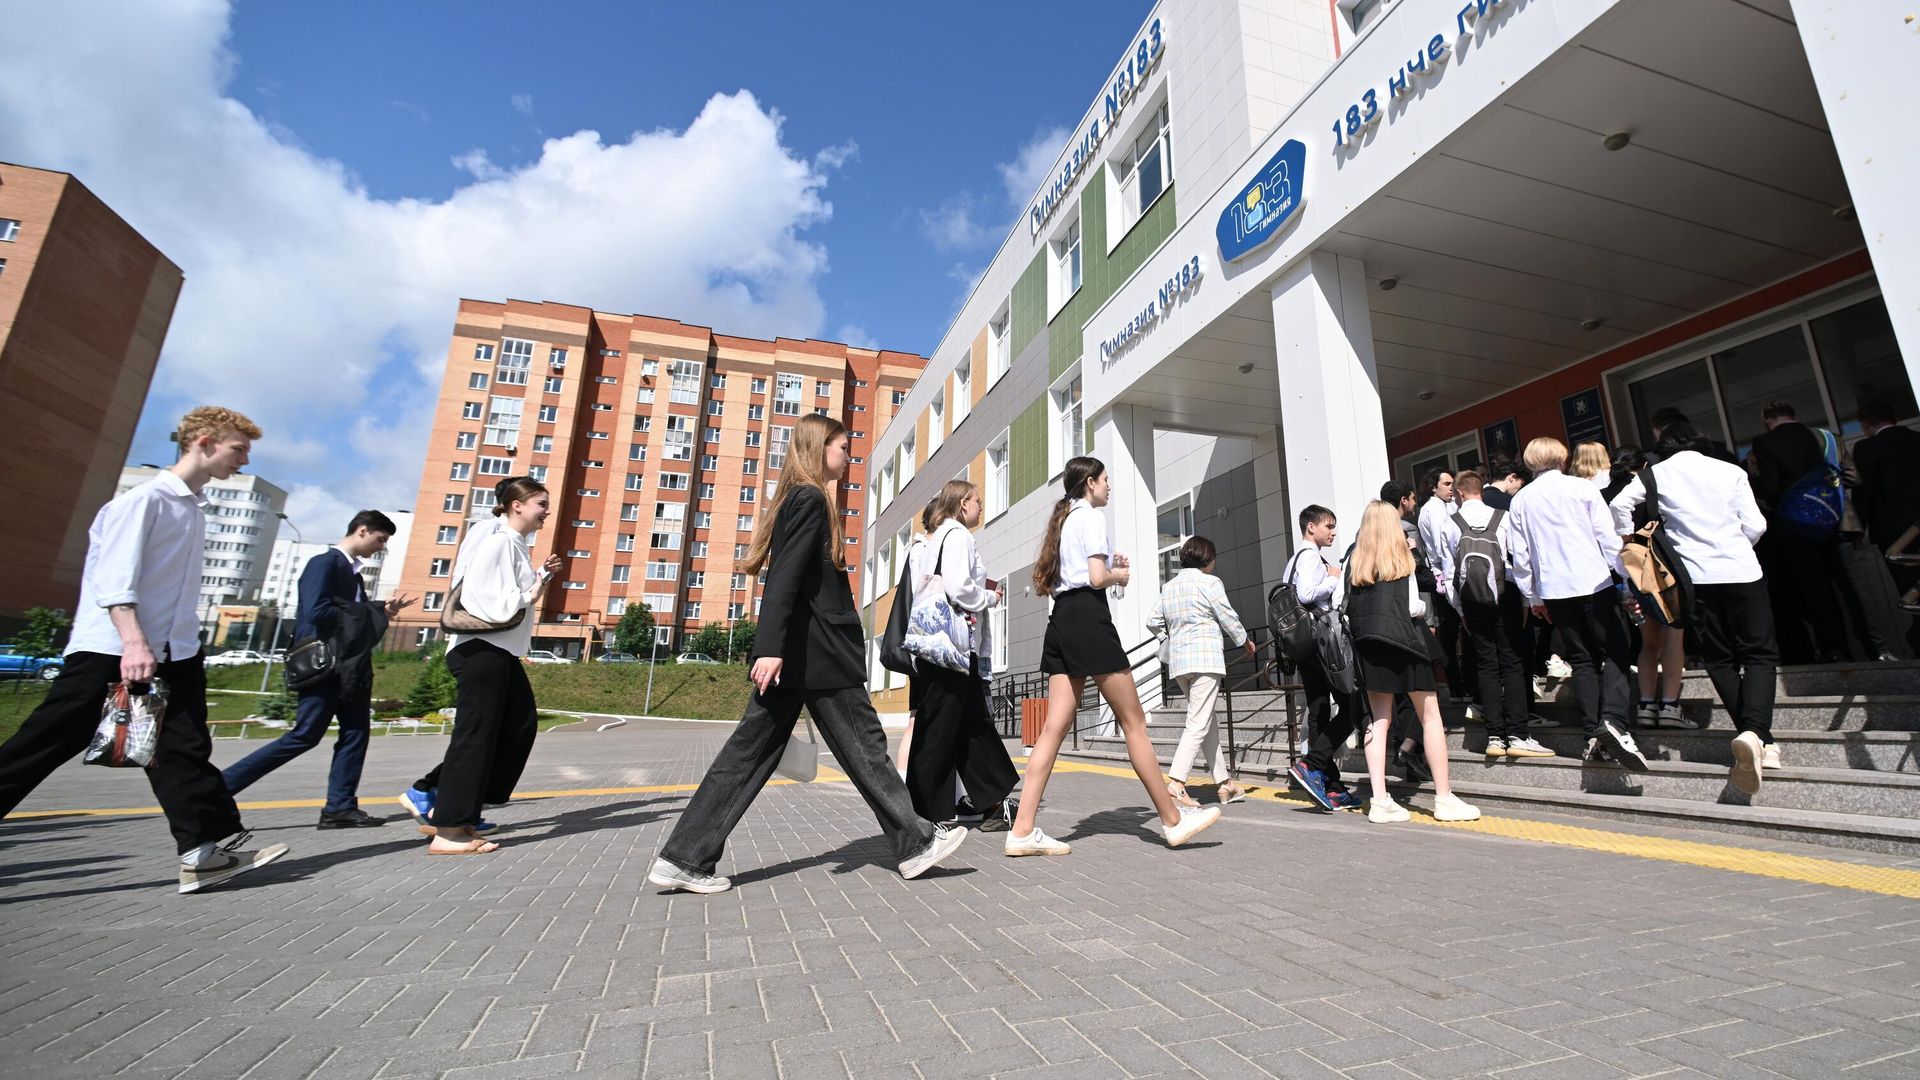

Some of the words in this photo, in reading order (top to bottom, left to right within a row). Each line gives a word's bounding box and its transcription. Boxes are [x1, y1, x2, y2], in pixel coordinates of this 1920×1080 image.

[1030, 117, 1100, 236] Гимназия
[1104, 17, 1162, 127] №183
[1332, 88, 1377, 146] 183
[1388, 33, 1444, 98] нче
[1230, 160, 1291, 243] 183
[1259, 196, 1292, 232] гимназия
[1100, 301, 1155, 362] Гимназия
[1158, 255, 1200, 309] №183
